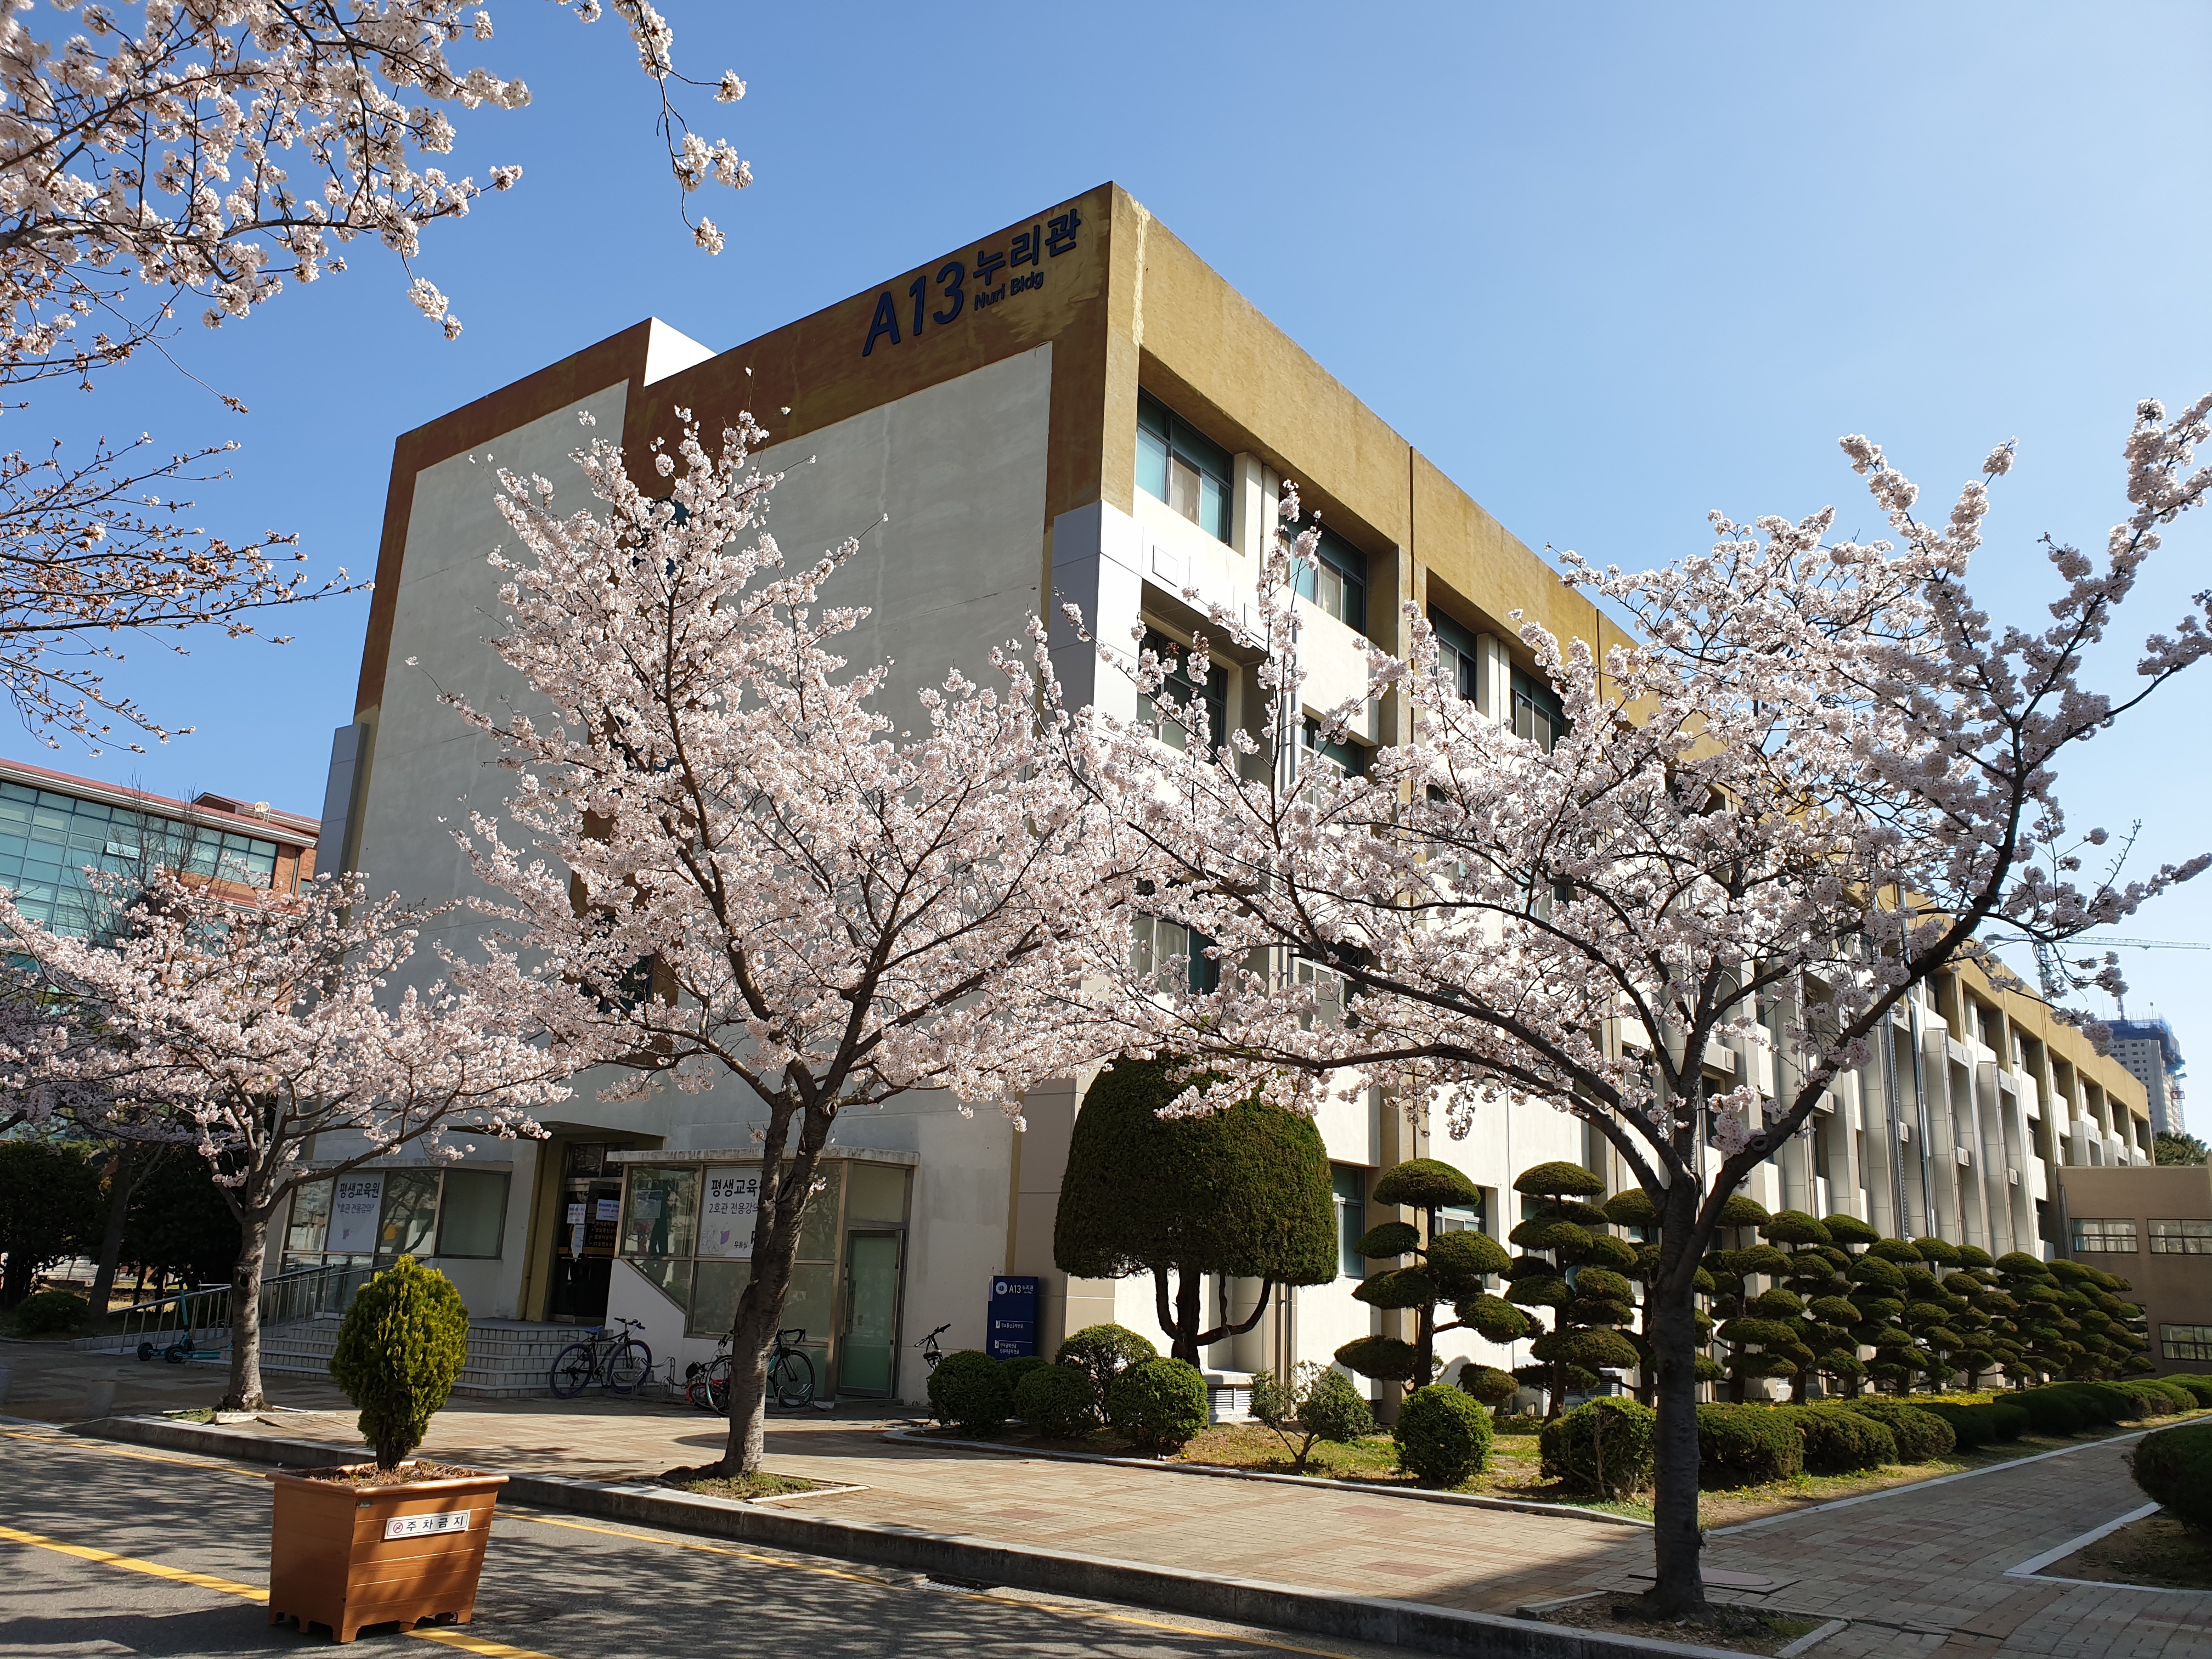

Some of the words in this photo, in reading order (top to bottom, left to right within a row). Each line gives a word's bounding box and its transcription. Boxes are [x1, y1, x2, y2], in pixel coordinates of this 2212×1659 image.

[862, 262, 965, 357] A13
[973, 208, 1081, 285] 누리관
[974, 283, 1005, 311] Nuri
[1010, 271, 1044, 296] Bldg
[339, 1181, 380, 1199] 평생교육원
[711, 1178, 761, 1197] 평생교육
[709, 1203, 728, 1214] 2호관
[1009, 1284, 1021, 1294] A13
